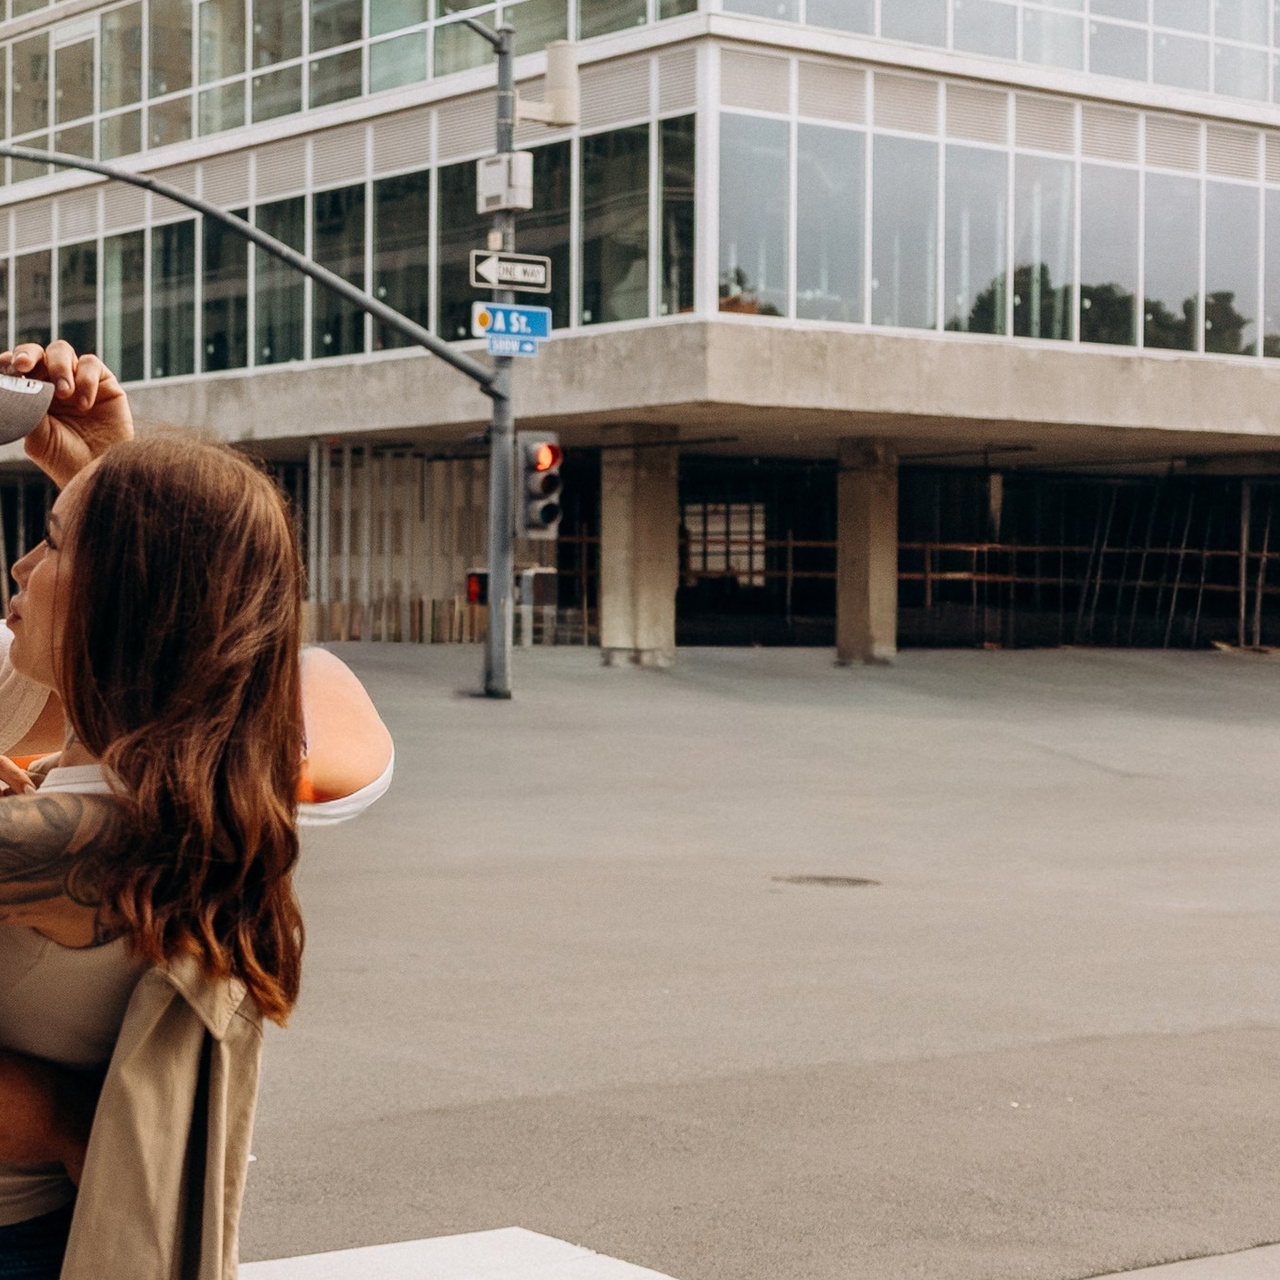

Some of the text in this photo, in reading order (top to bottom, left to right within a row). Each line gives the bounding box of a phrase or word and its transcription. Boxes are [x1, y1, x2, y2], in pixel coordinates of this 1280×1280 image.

[499, 264, 541, 278] ONE WAY
[493, 310, 506, 332] A
